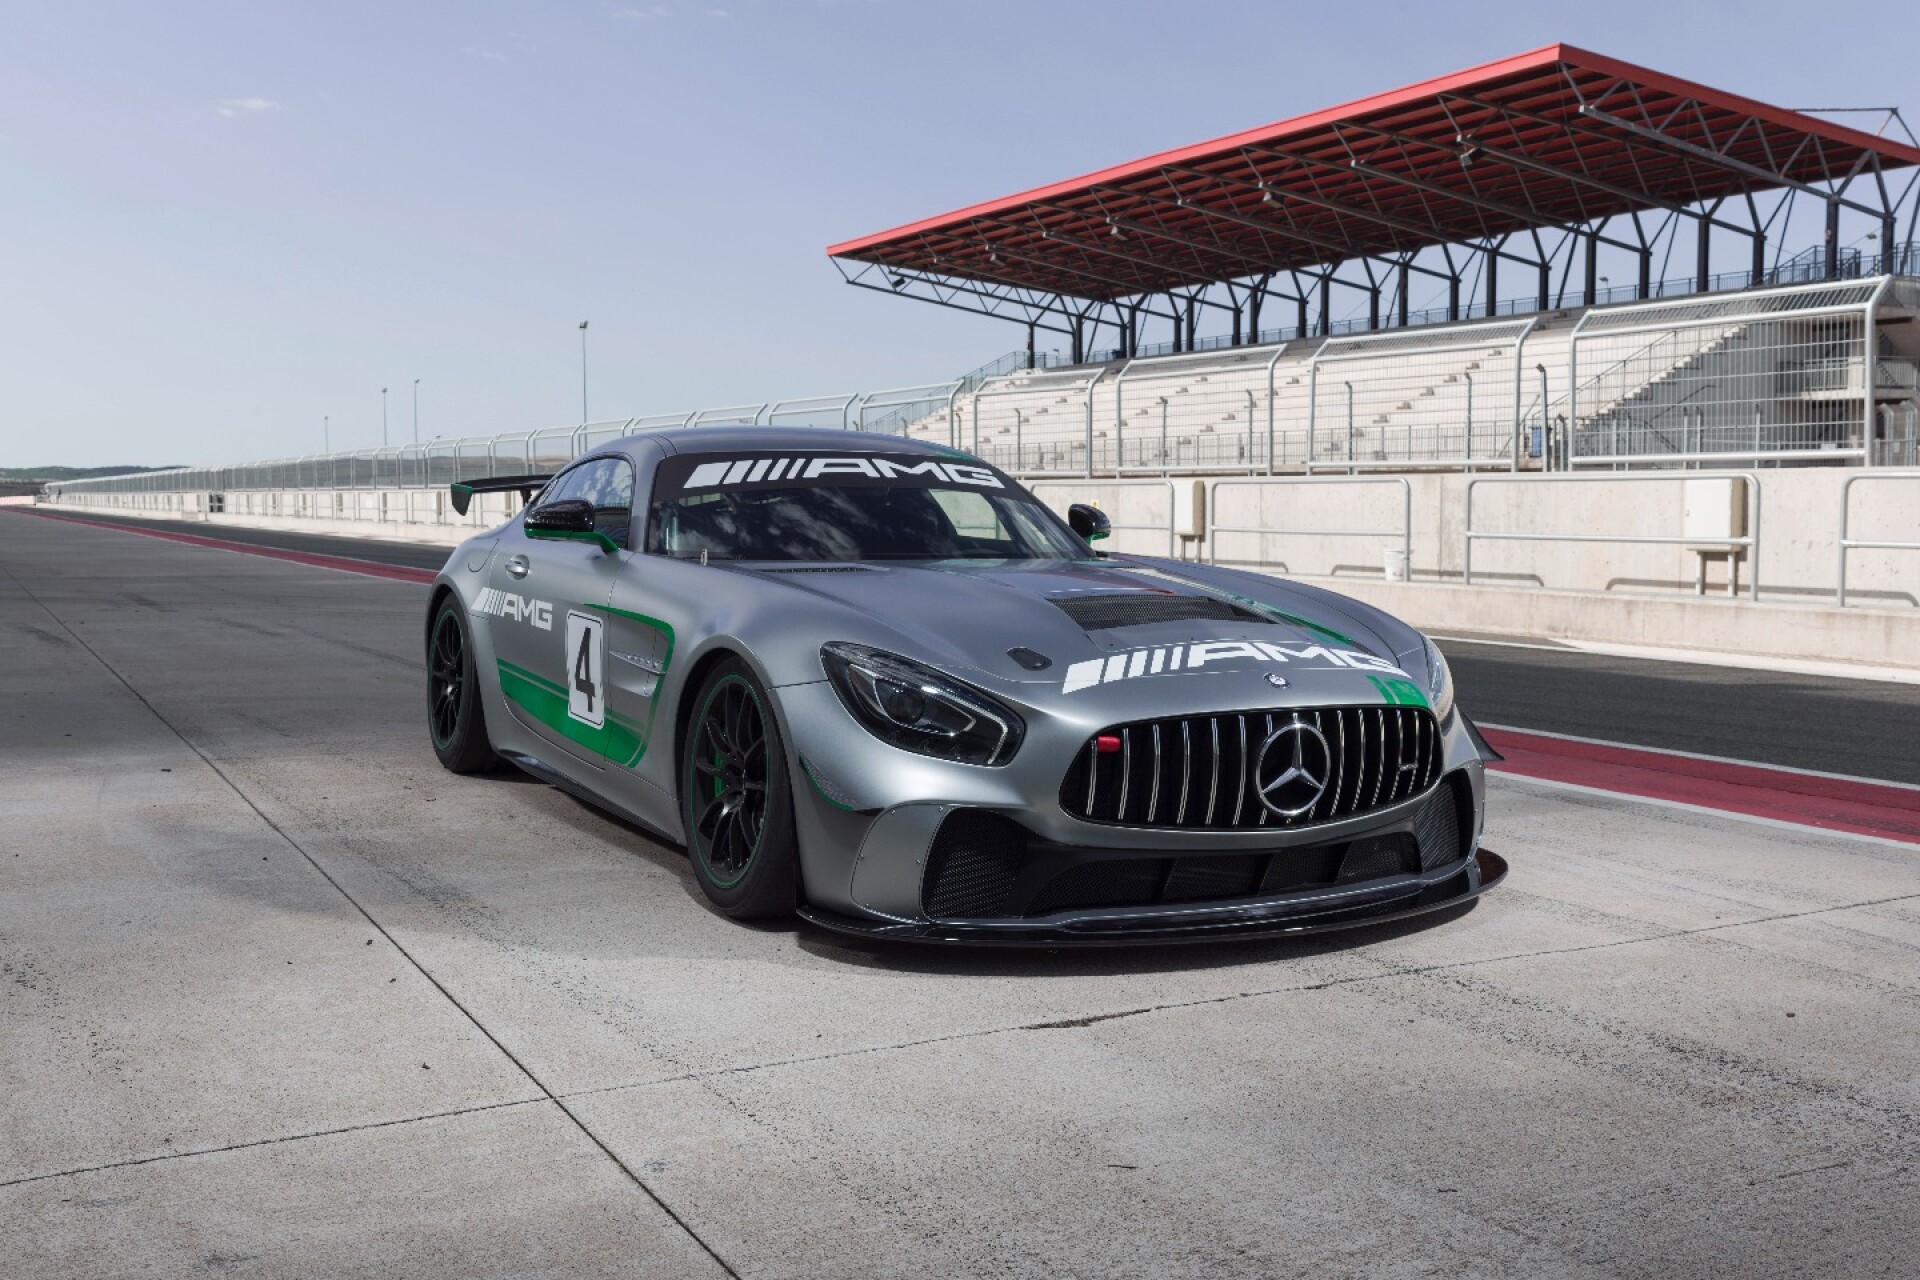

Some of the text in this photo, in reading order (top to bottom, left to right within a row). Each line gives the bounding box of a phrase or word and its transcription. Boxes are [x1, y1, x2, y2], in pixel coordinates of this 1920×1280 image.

[802, 458, 1005, 489] AMG
[500, 592, 553, 632] AMG
[575, 626, 596, 713] 4
[1187, 642, 1413, 680] AMG
